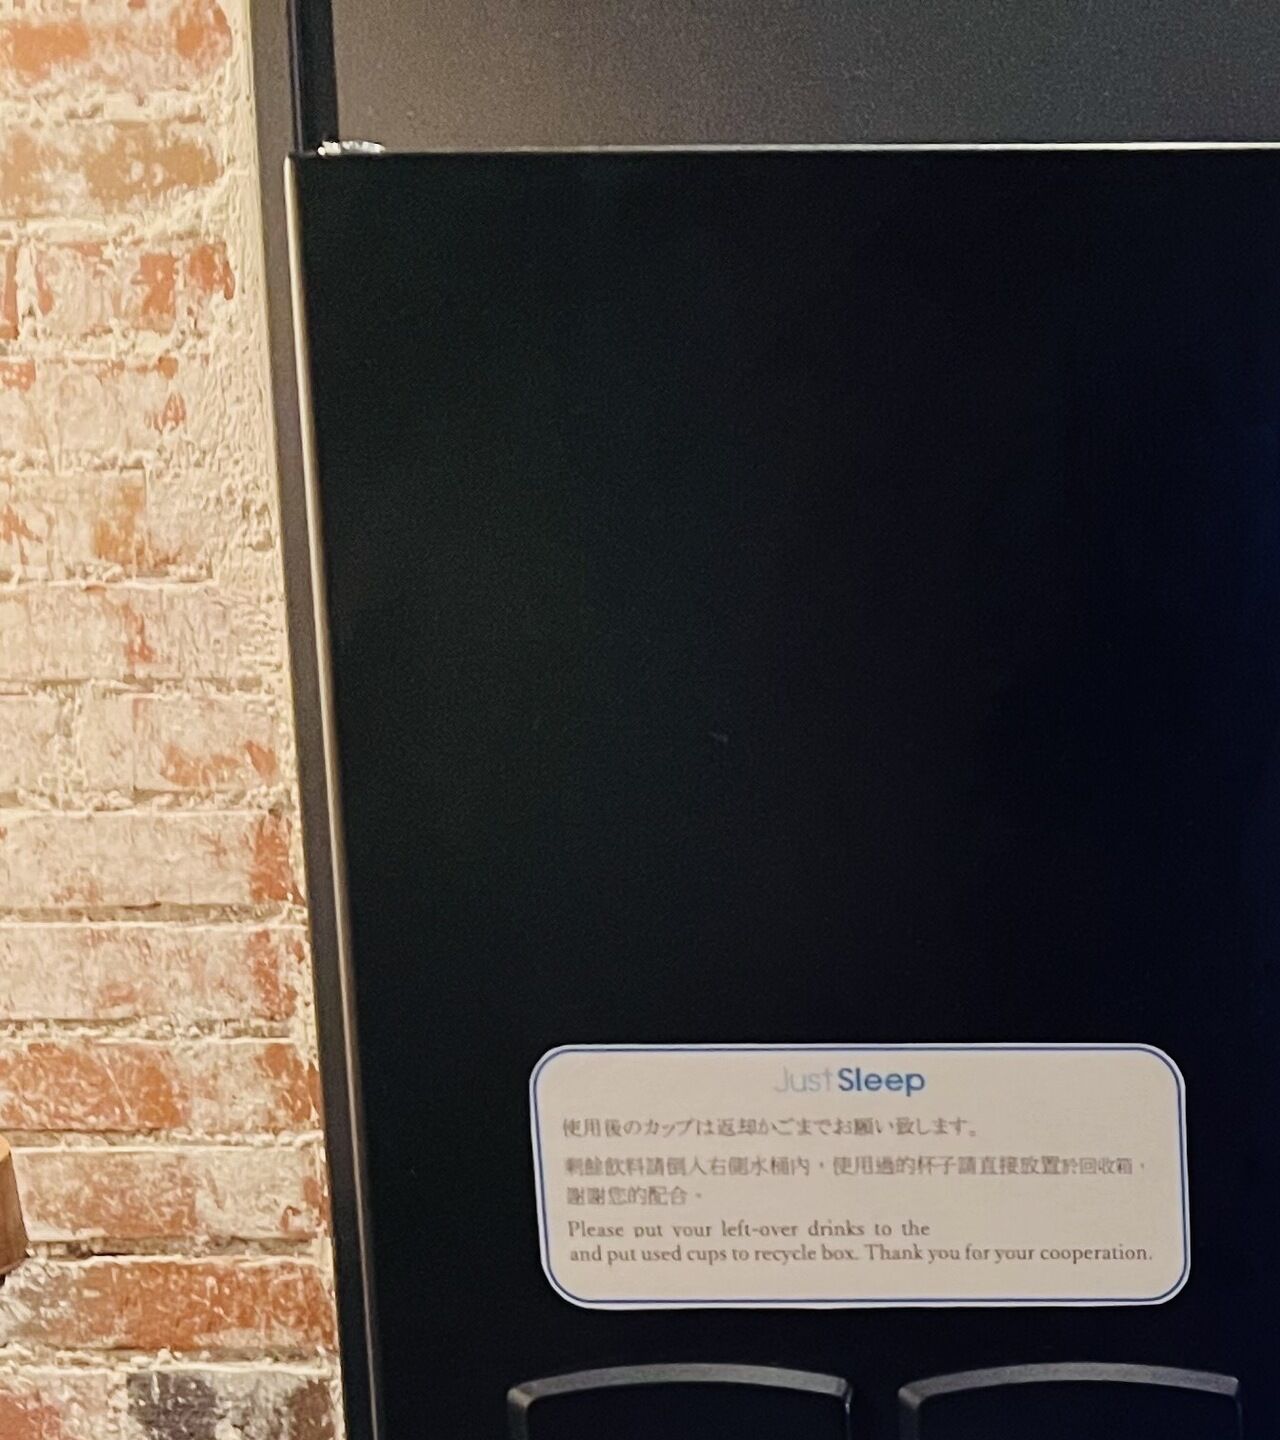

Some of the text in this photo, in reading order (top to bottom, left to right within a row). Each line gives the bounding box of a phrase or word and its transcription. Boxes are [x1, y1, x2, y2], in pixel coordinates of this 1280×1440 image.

[568, 1220, 624, 1238] Please
[722, 1219, 799, 1238] left-over
[808, 1219, 865, 1237] drinks
[875, 1222, 892, 1236] to
[902, 1219, 931, 1236] the
[570, 1245, 602, 1262] and
[607, 1247, 637, 1266] put
[641, 1244, 682, 1261] used
[687, 1248, 727, 1266] cups
[731, 1247, 749, 1261] to
[754, 1243, 816, 1265] recycle
[865, 1243, 923, 1261] Thank
[928, 1249, 961, 1265] you
[965, 1243, 989, 1260] for
[994, 1248, 1034, 1265] your
[1040, 1243, 1152, 1265] cooperation.
